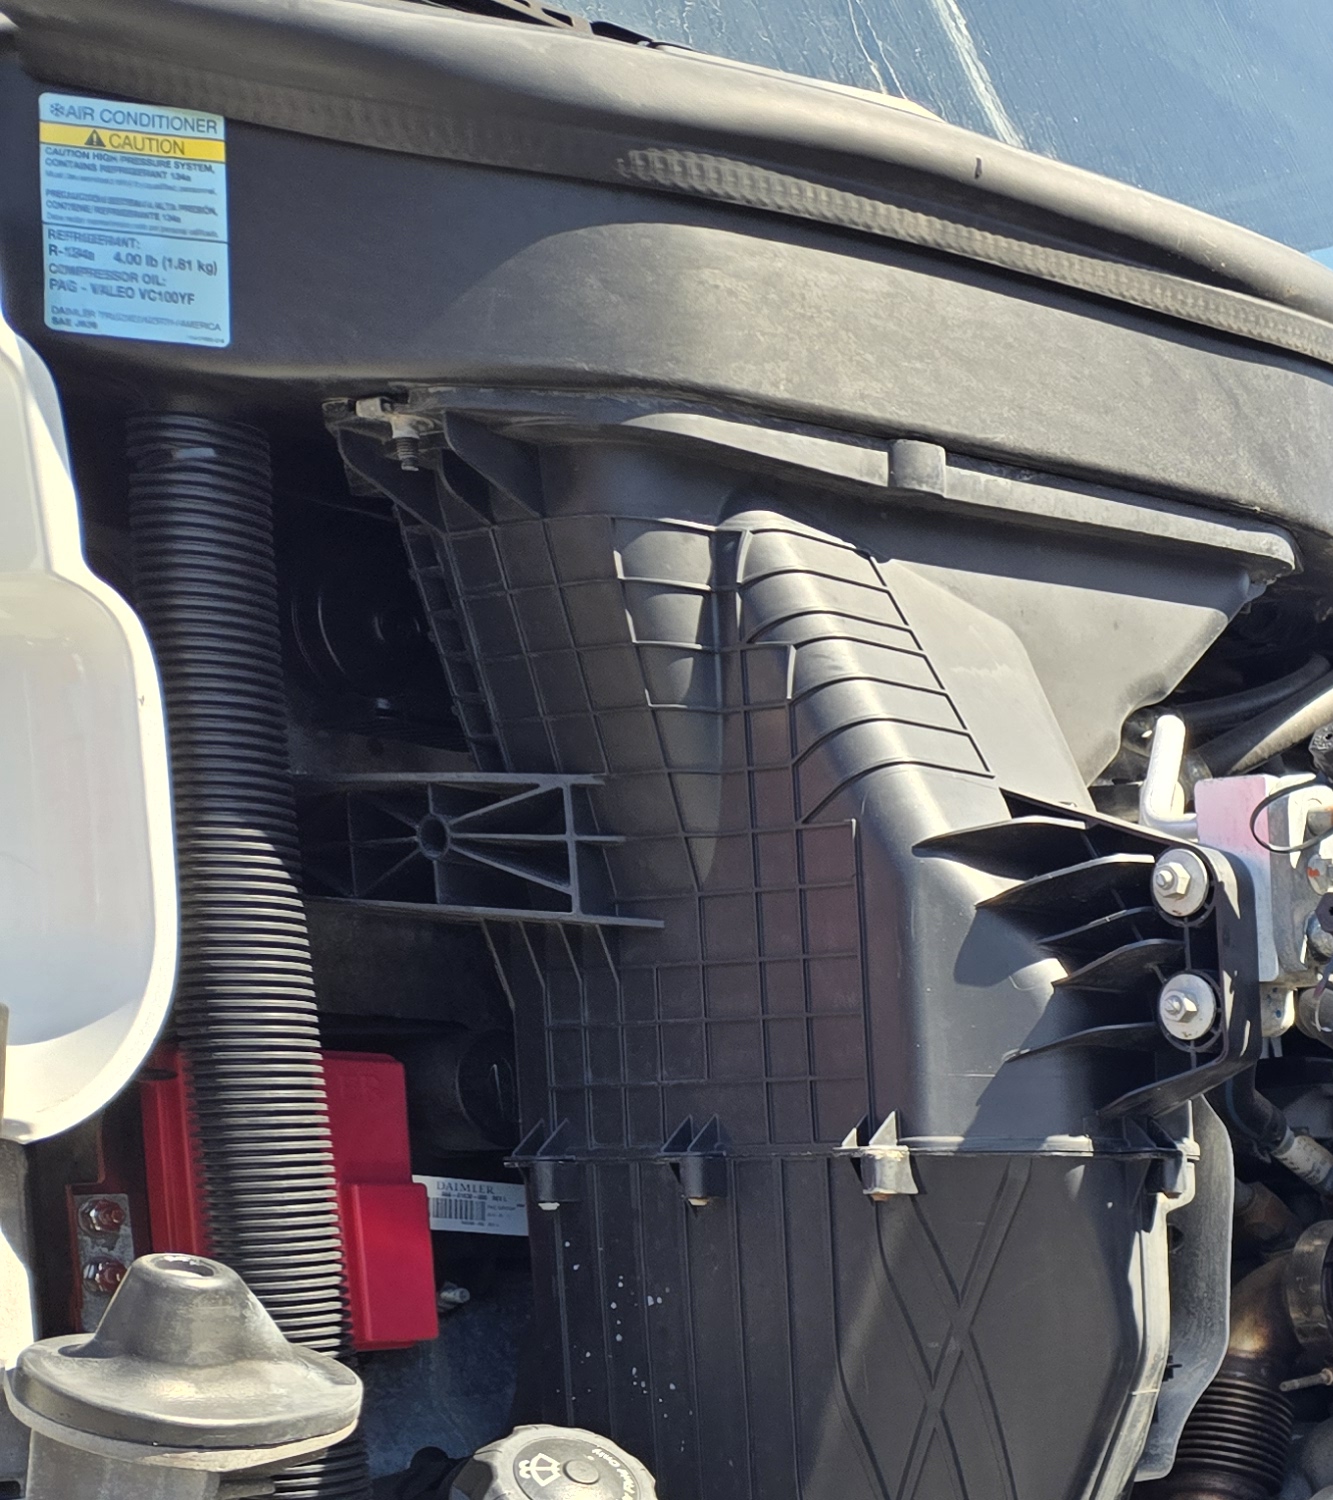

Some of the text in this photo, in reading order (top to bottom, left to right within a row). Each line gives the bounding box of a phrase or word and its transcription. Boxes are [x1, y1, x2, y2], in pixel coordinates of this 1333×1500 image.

[65, 105, 217, 134] AIR CONDITIONER
[109, 133, 185, 155] CAUTION
[45, 147, 90, 161] CAUTION
[120, 155, 171, 169] PRESSURE
[48, 229, 141, 249] REFRIGERANT:
[49, 263, 167, 286] COMPRESSOR OIL:
[113, 251, 143, 267] 4.00
[145, 254, 158, 268] lb
[196, 256, 218, 276] kg)
[50, 278, 77, 293] PAG
[90, 283, 135, 299] VALEO
[138, 287, 195, 305] VC100YF
[437, 1181, 495, 1194] DAIMLER
